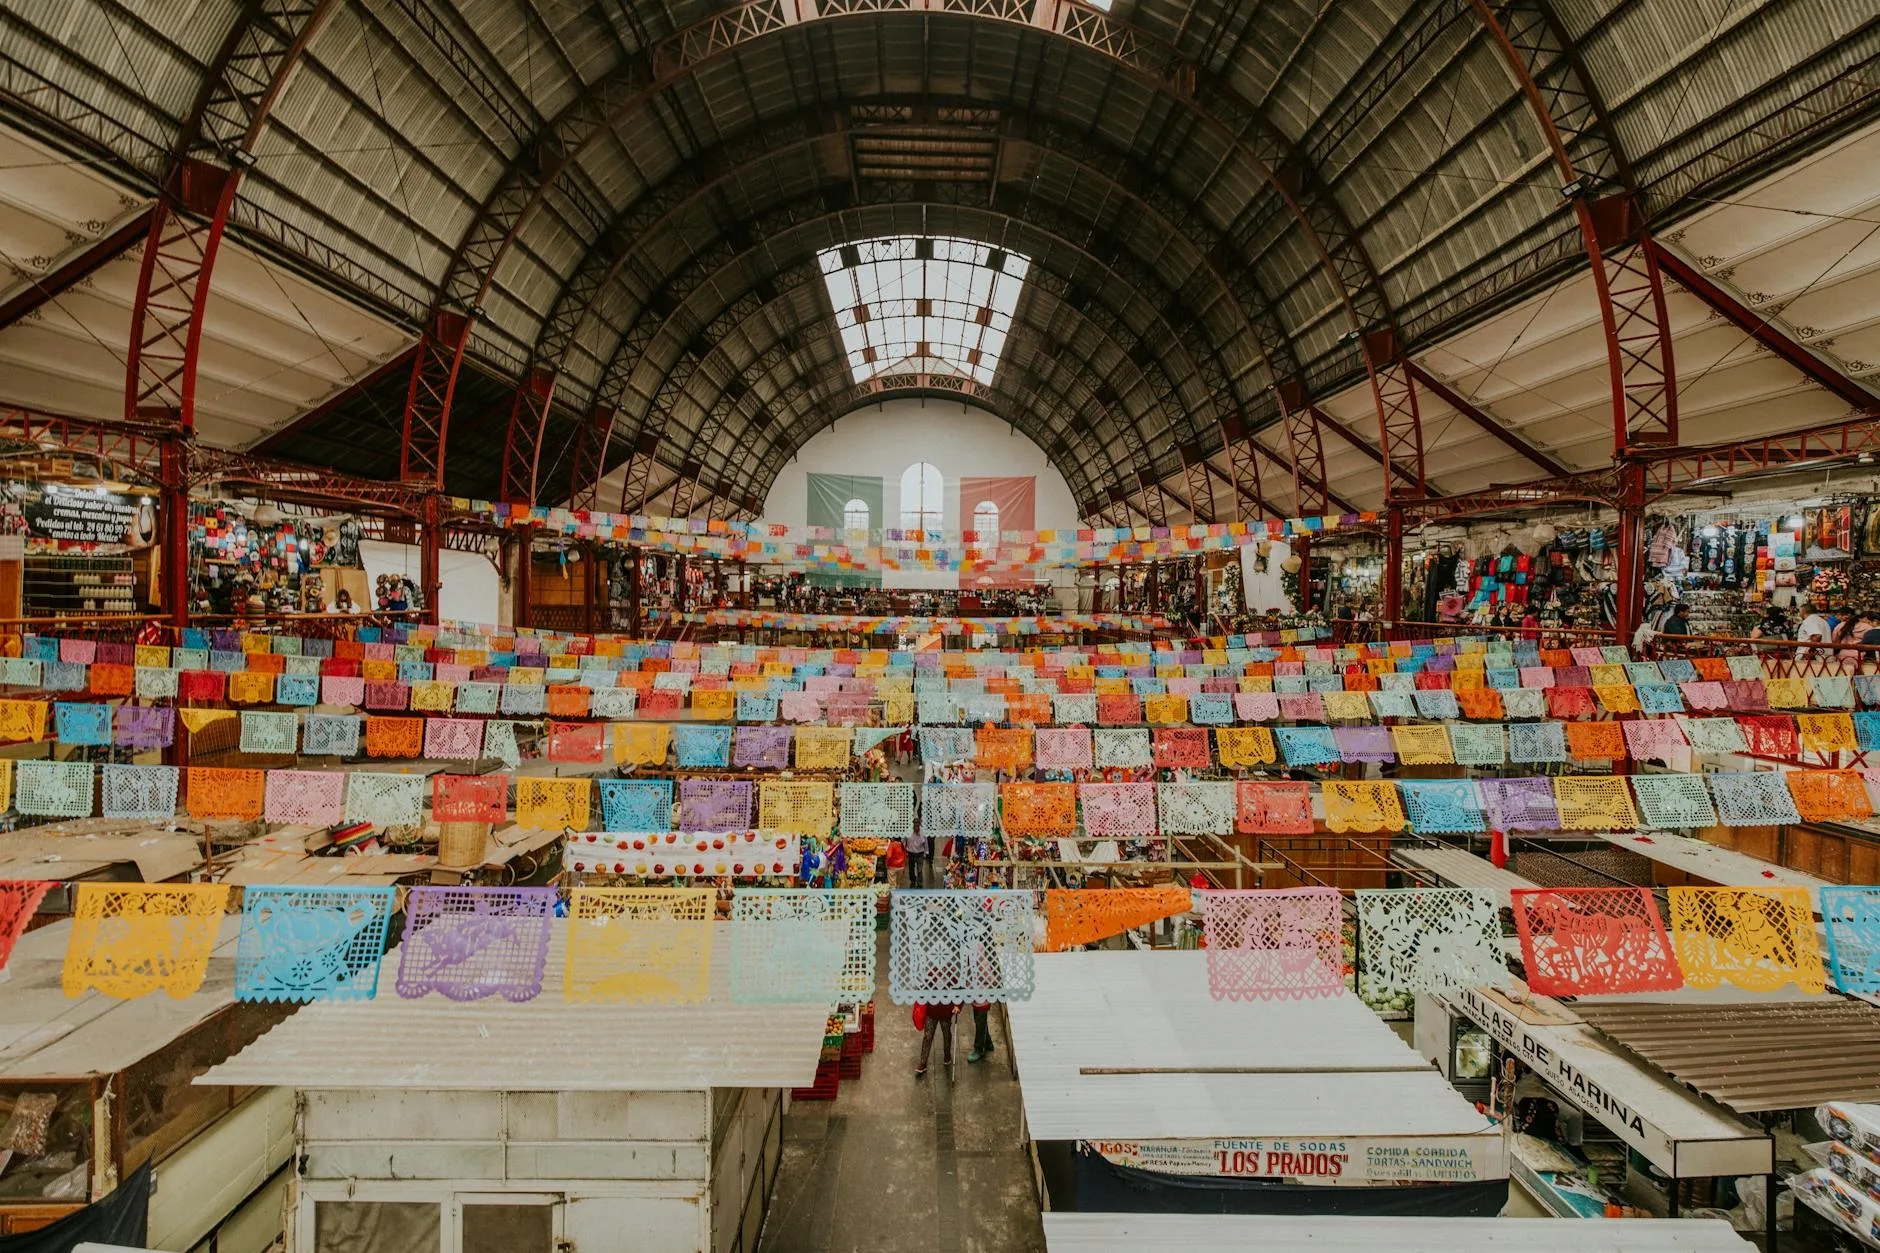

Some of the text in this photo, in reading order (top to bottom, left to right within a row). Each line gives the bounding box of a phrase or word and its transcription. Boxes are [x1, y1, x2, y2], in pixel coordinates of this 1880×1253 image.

[53, 496, 84, 509] Delicioso
[85, 500, 104, 511] sabor
[104, 503, 113, 512] de
[35, 517, 65, 529] Pedidos
[65, 520, 74, 530] al
[80, 530, 96, 540] todo
[1461, 990, 1645, 1139] ILLAS DE HARINA
[1545, 1068, 1565, 1087] QUESO
[1214, 1140, 1346, 1152] FUENTE DE SODAS
